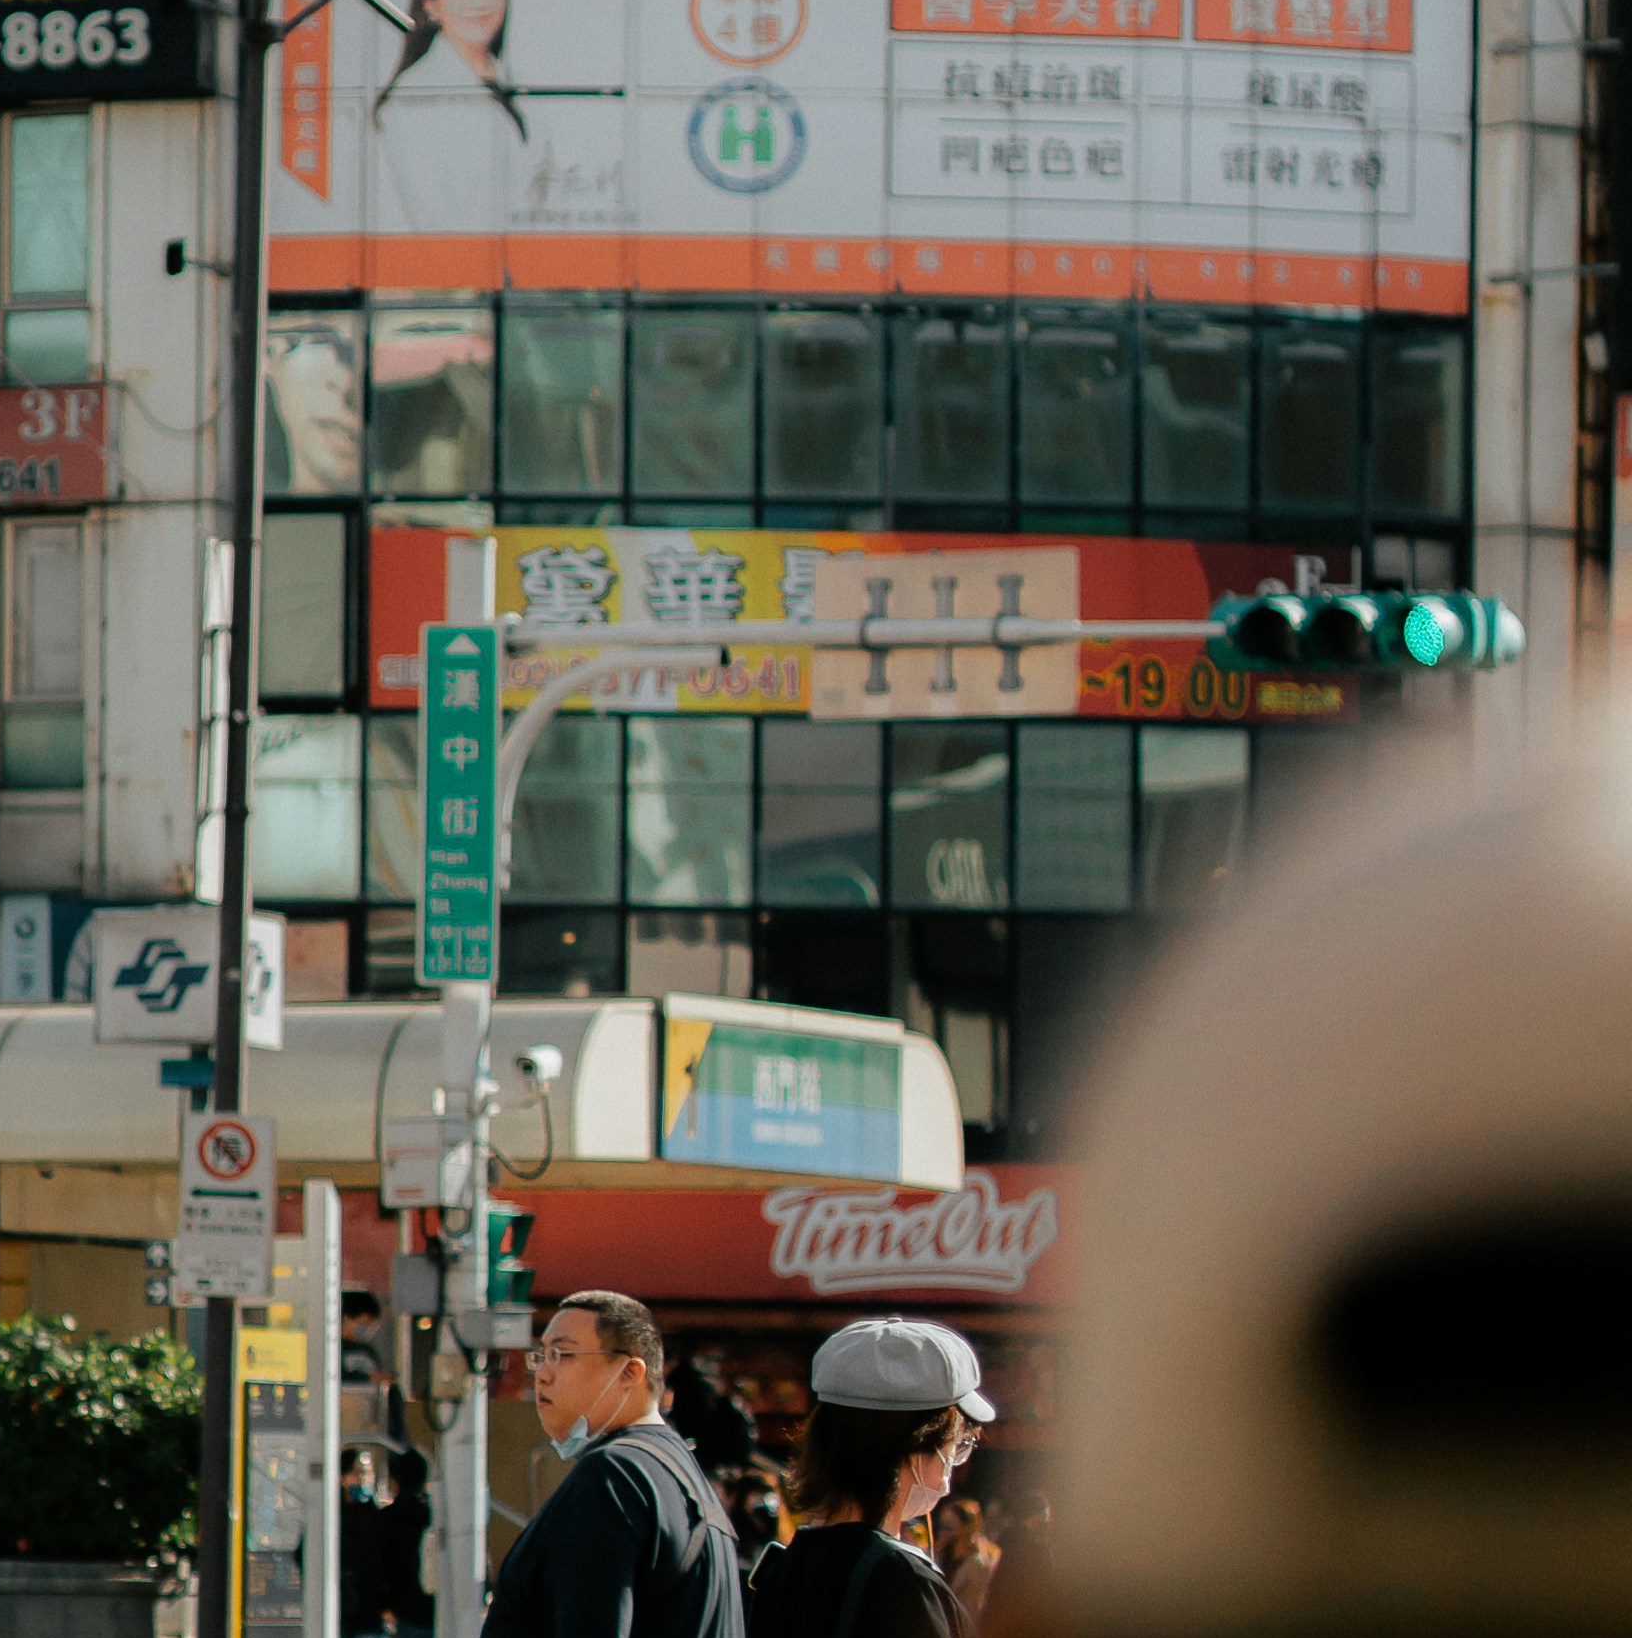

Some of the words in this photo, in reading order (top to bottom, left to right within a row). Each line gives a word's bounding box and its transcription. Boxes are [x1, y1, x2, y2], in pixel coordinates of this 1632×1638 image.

[20, 390, 99, 440] 3F
[442, 669, 481, 836] 漢中街
